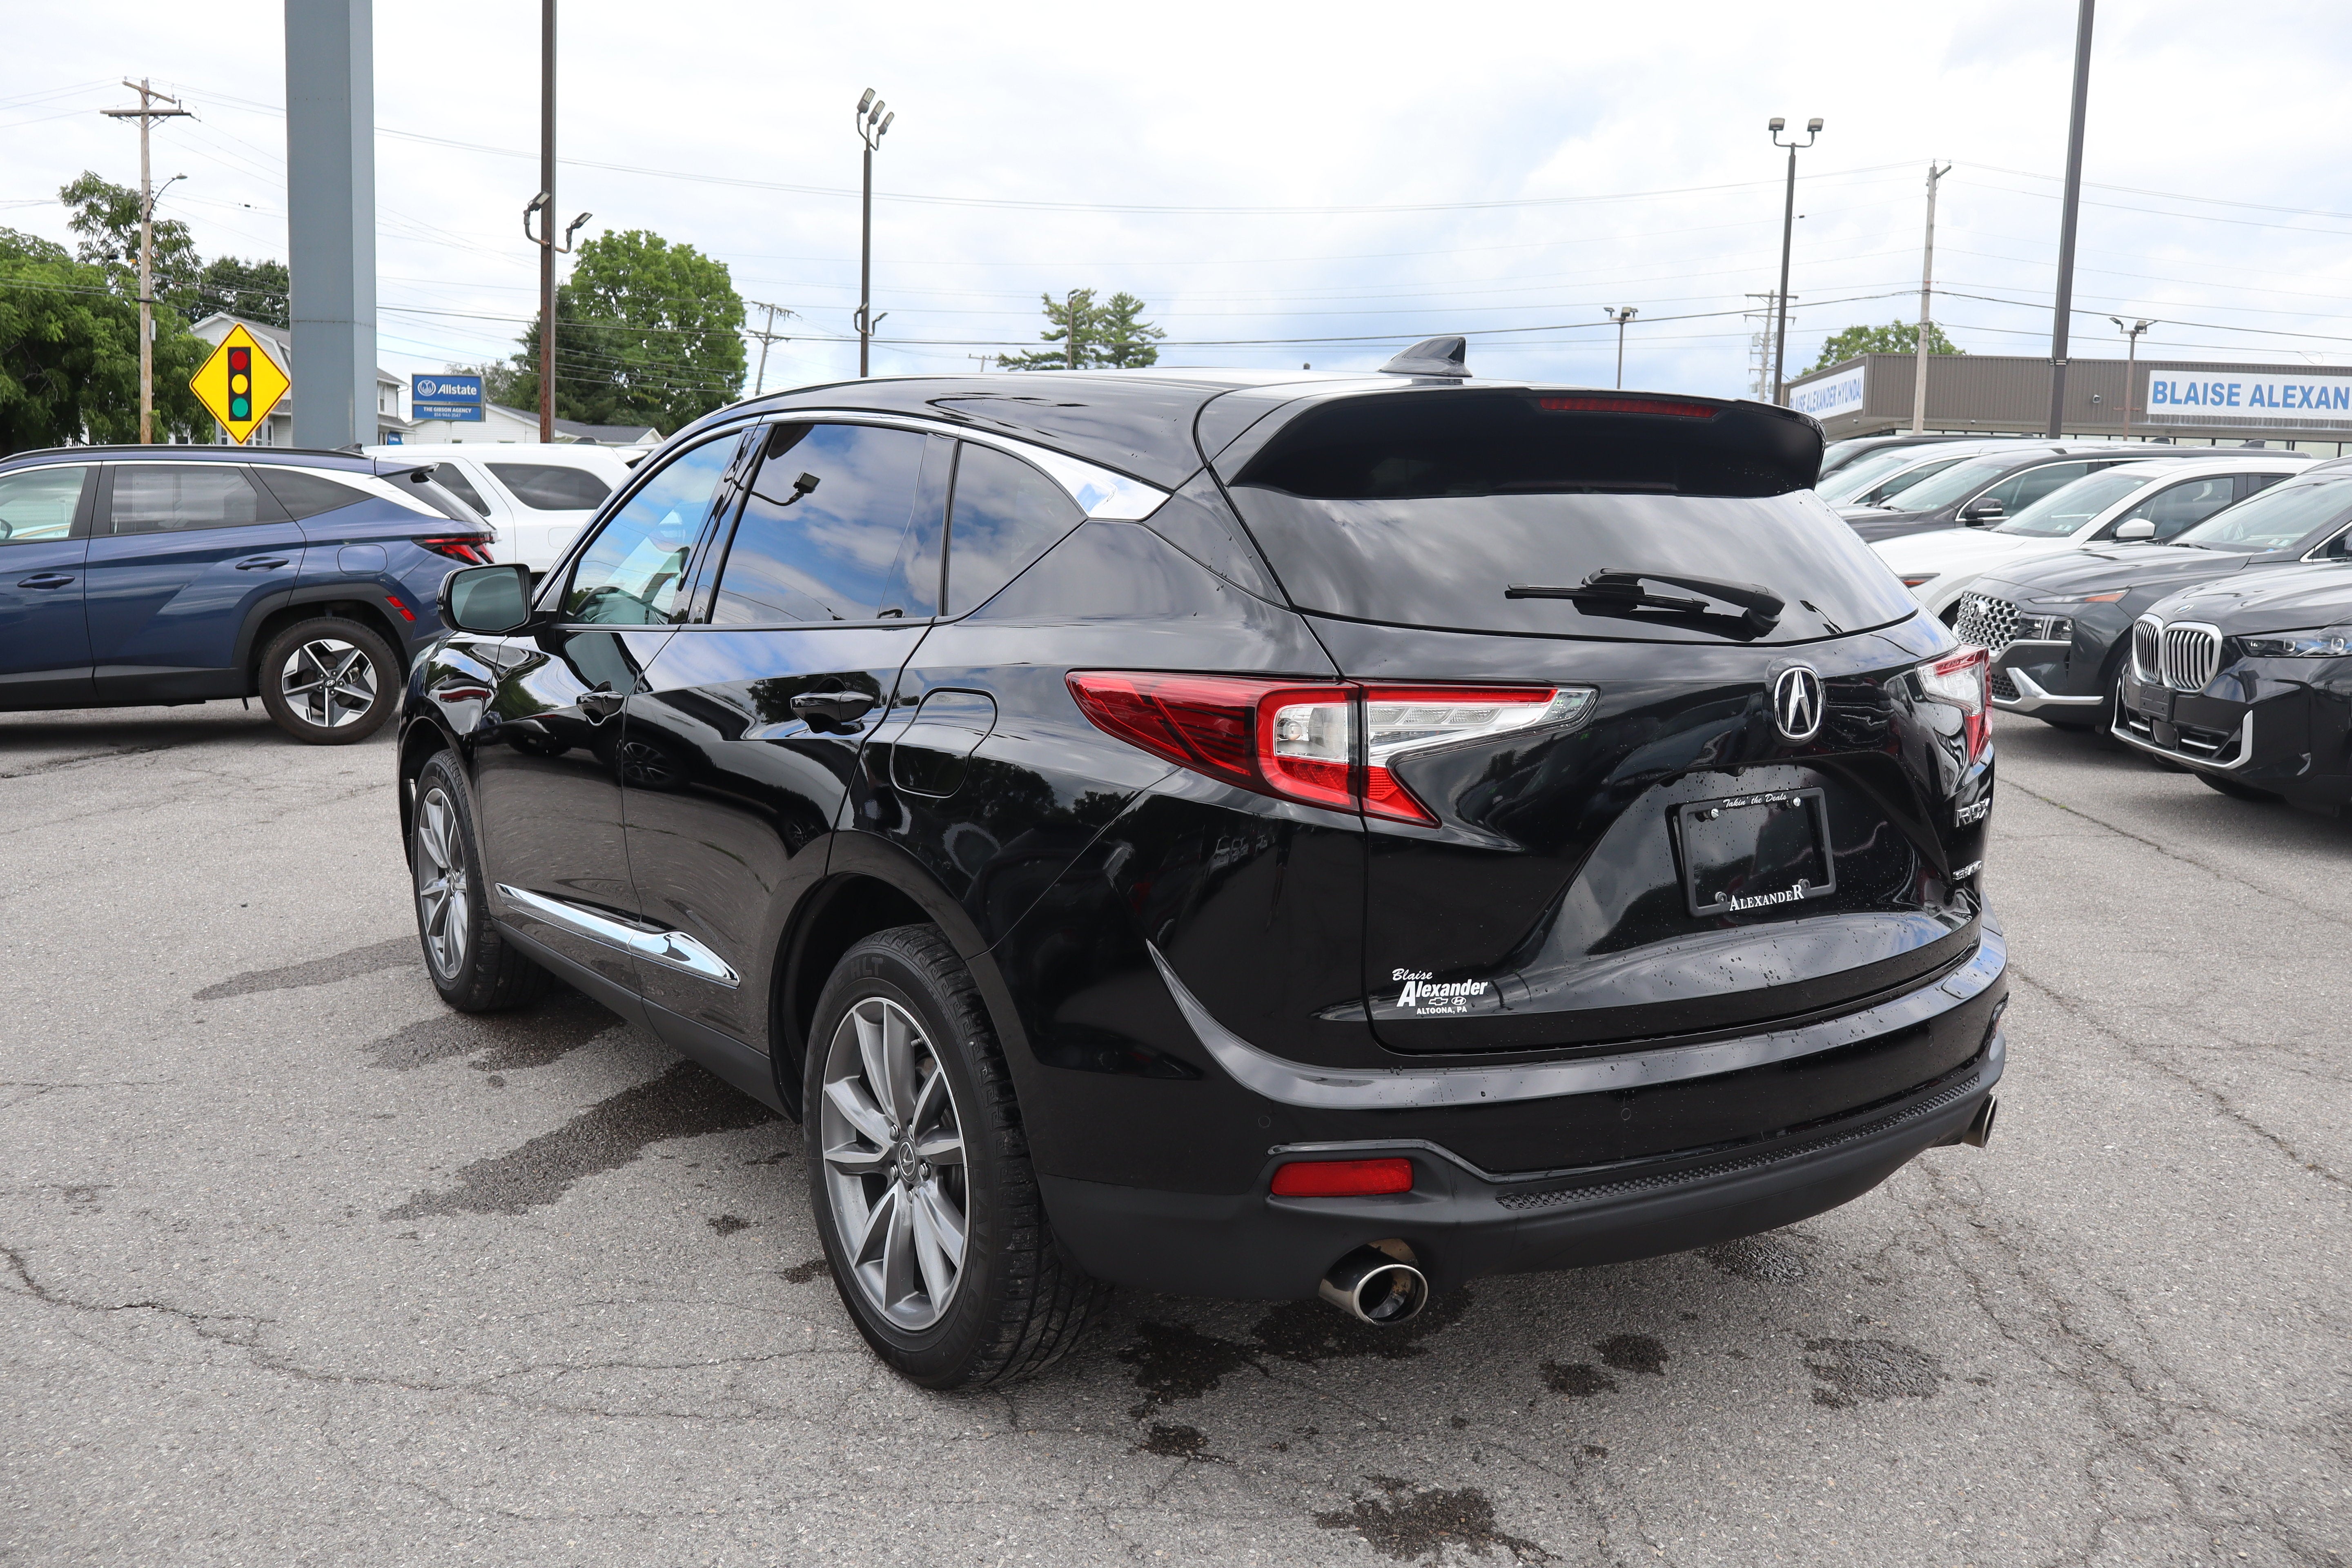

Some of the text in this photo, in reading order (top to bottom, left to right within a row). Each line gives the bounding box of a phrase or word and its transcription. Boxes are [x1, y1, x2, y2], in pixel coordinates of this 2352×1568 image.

[437, 384, 477, 395] Allstate
[1806, 385, 1837, 413] ALEXANDER
[1838, 376, 1862, 406] HYUNDAI
[2152, 381, 2352, 410] BLAISE ALEXAN
[1723, 793, 1787, 808] Takin' the Deals
[1729, 884, 1804, 911] ALEXANDER
[850, 956, 884, 980] HLT
[1392, 968, 1433, 981] Blaise
[1396, 979, 1488, 1007] Alexander
[1417, 1006, 1455, 1014] ALTOONA,
